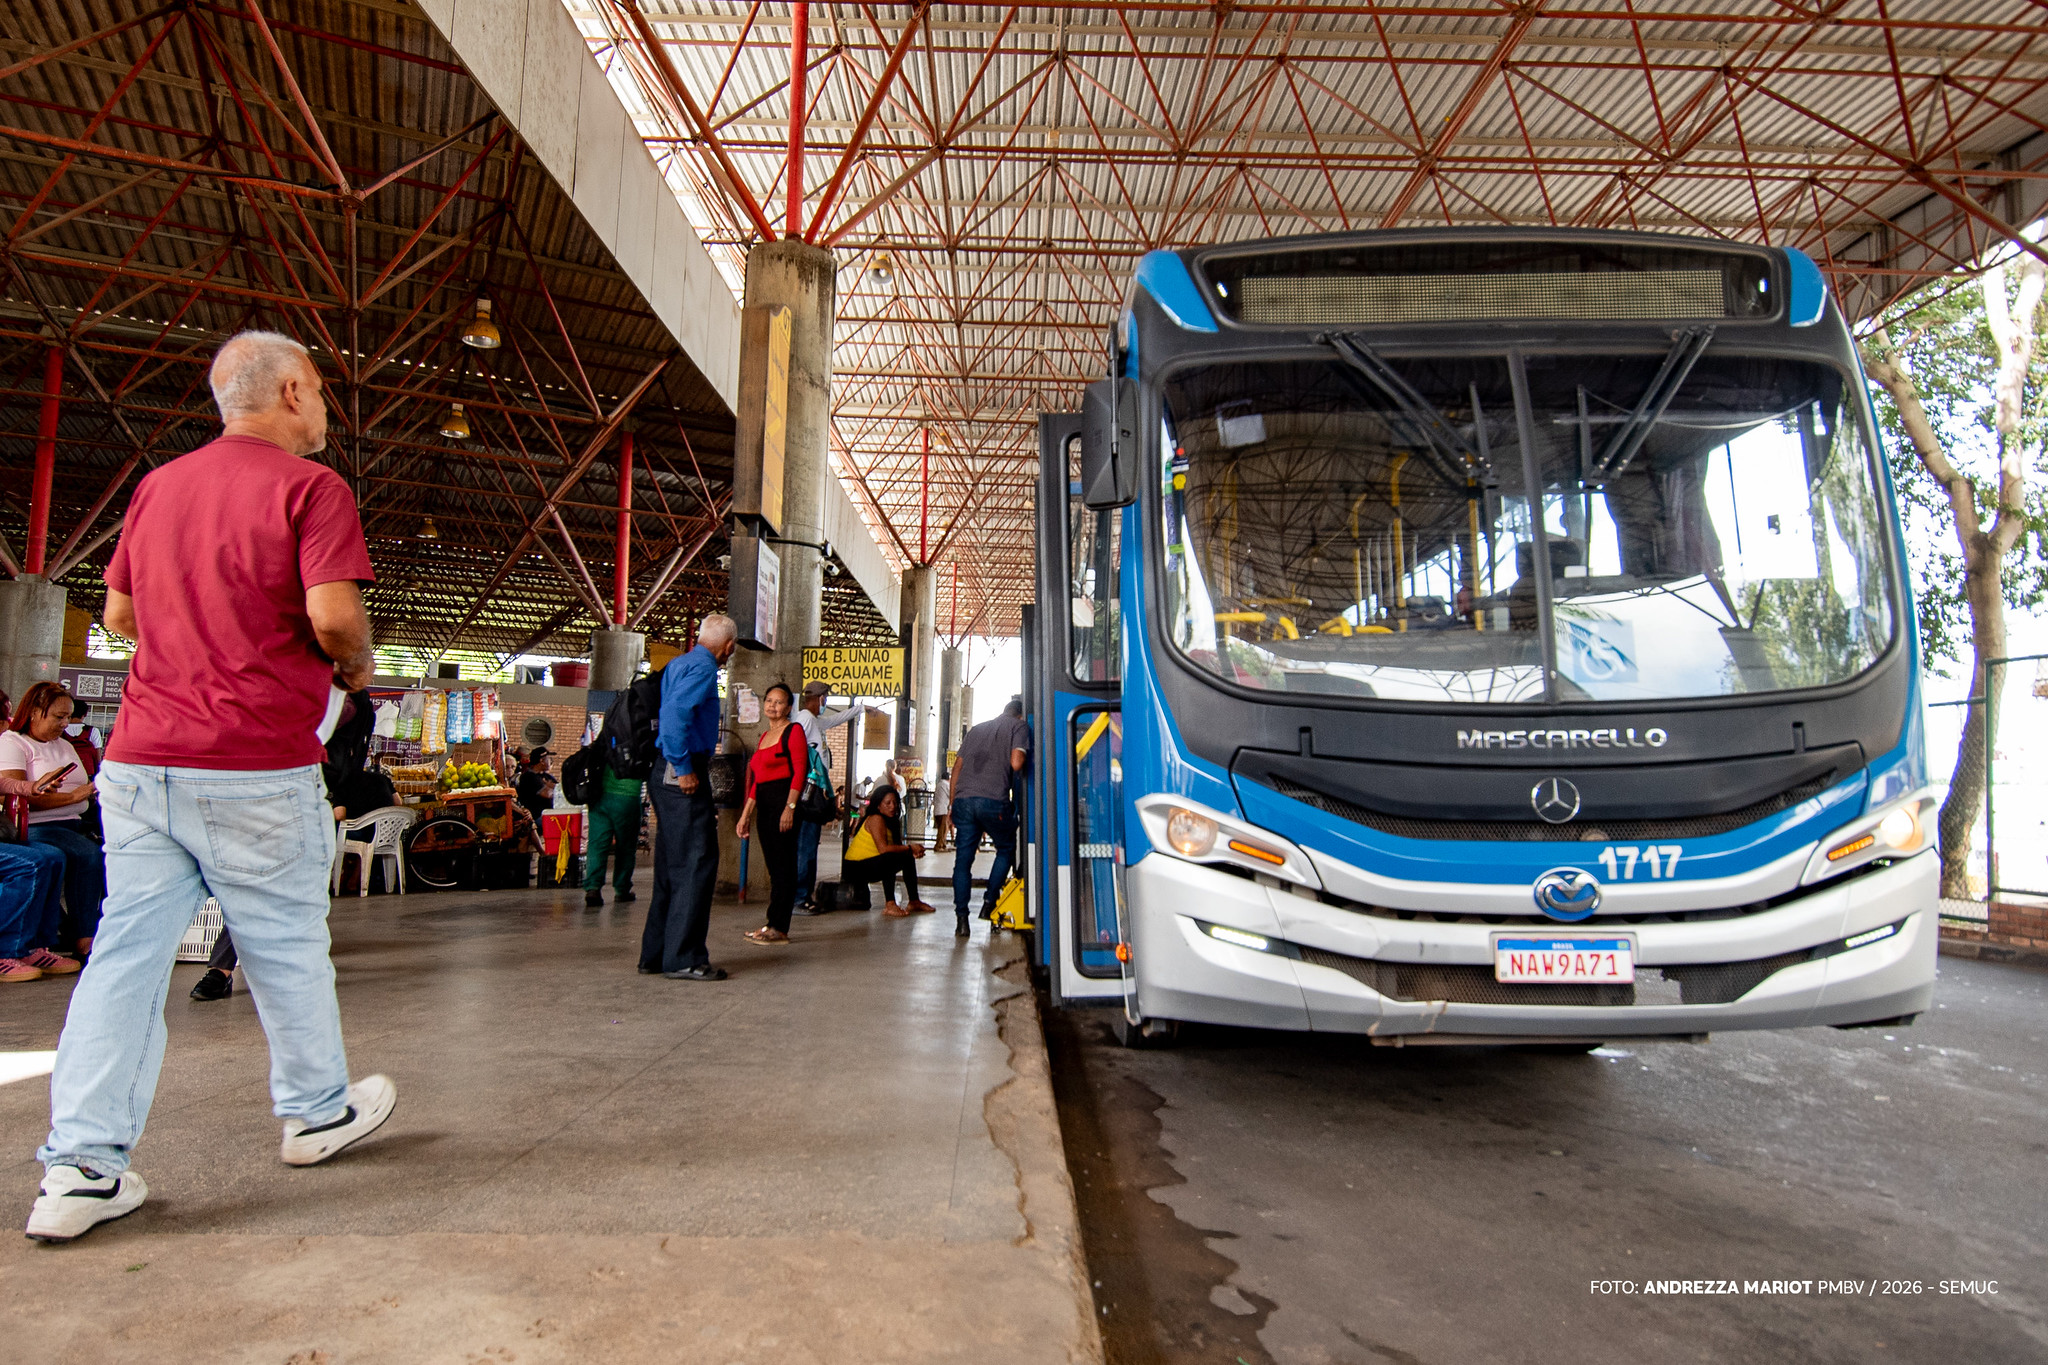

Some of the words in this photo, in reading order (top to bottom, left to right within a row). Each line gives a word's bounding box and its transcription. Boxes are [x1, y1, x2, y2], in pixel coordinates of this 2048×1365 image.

[803, 650, 827, 663] 104
[833, 650, 846, 663] B.
[802, 666, 828, 679] 308
[1456, 728, 1668, 748] MASCARELLO
[1598, 845, 1683, 880] 1717
[1551, 942, 1574, 950] BRASIL
[1510, 953, 1618, 976] NAW9A71
